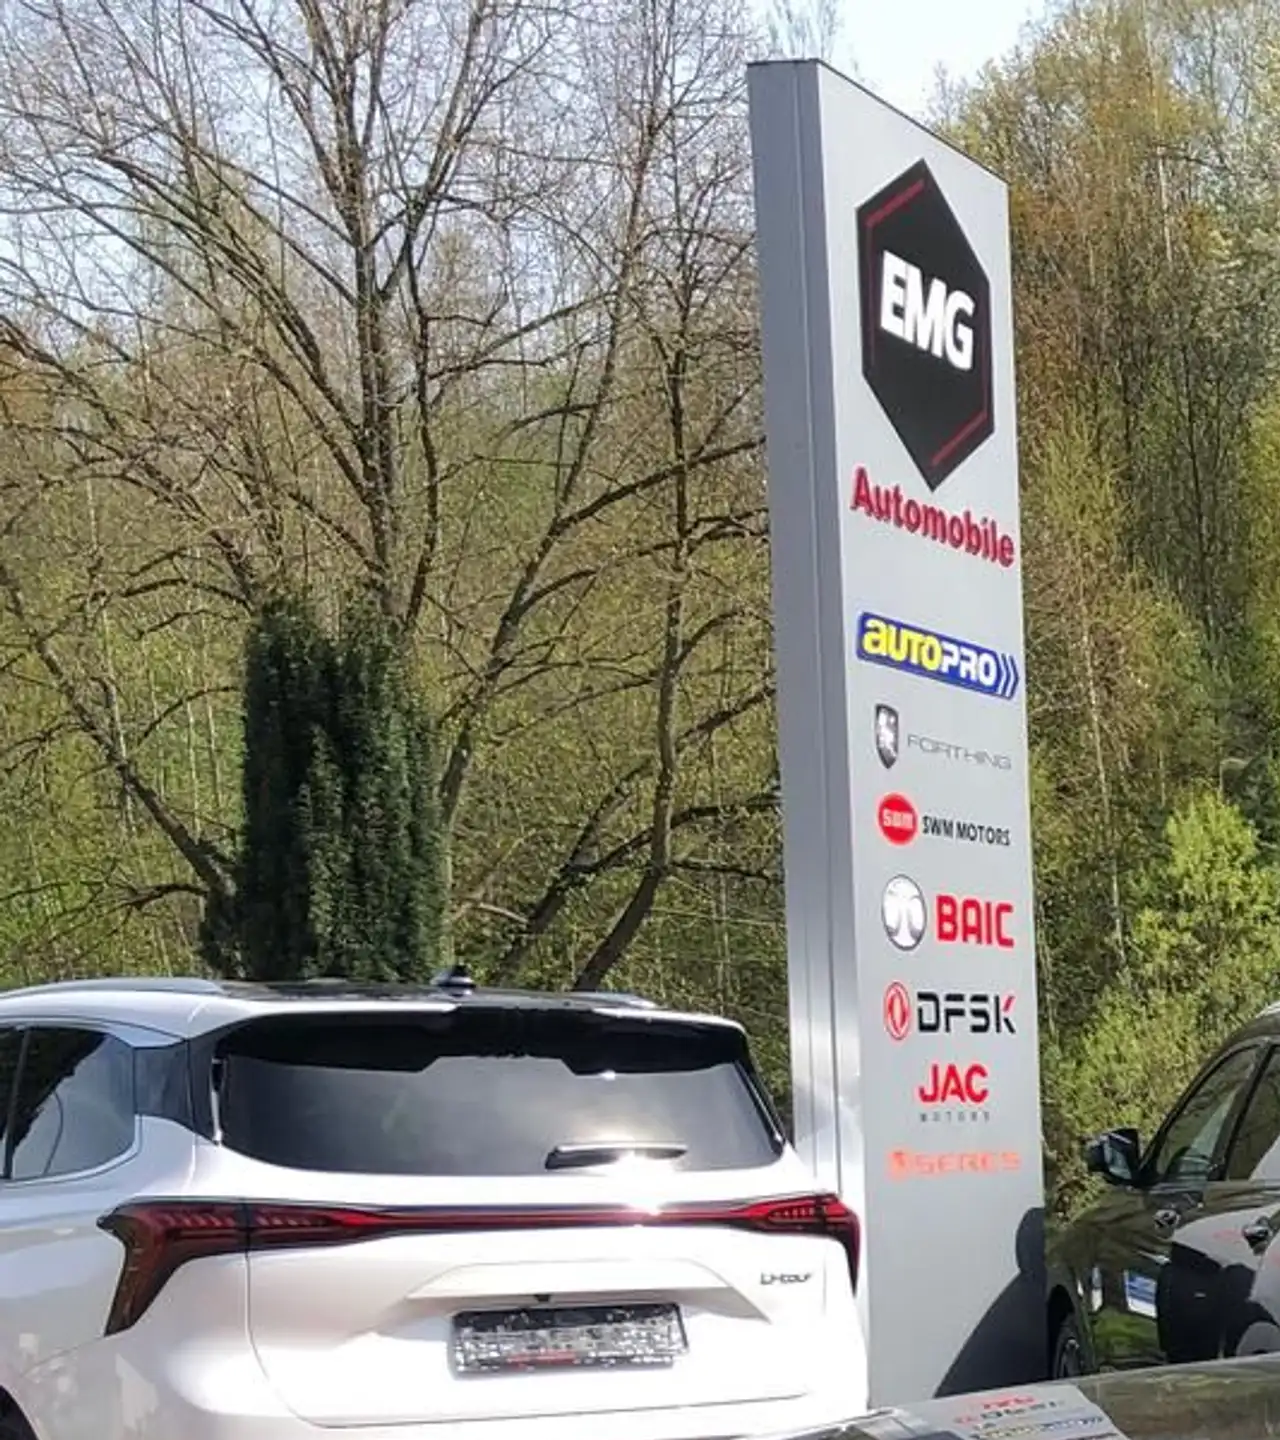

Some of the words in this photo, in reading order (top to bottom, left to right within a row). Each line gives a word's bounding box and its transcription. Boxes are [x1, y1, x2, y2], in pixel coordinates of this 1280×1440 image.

[880, 249, 975, 371] EMG
[849, 466, 1015, 567] Automobile
[906, 733, 1012, 770] FORTHING
[922, 815, 954, 839] SWM
[956, 820, 1011, 846] MOTORS
[935, 894, 1015, 949] BAIC
[916, 991, 1016, 1035] DFSK
[918, 1062, 989, 1104] JAC
[914, 1151, 1021, 1175] SERES
